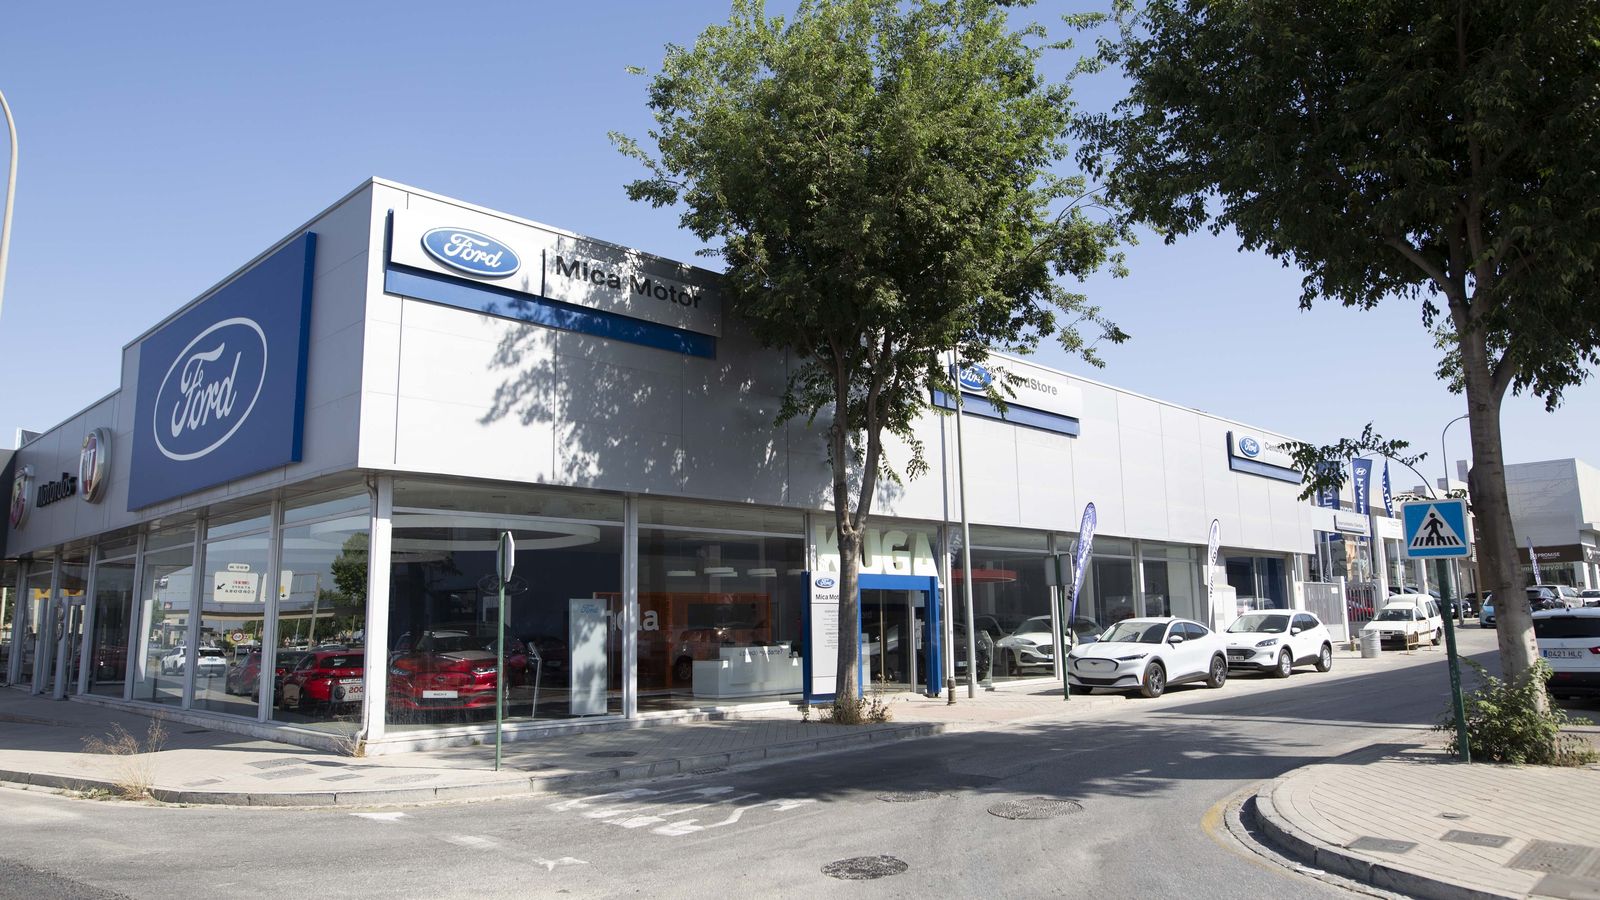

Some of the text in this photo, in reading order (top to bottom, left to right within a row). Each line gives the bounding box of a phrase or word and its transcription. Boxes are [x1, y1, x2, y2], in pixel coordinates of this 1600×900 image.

[444, 234, 503, 269] Ford
[556, 256, 701, 308] Mica Motor
[171, 342, 242, 437] Ford
[1009, 374, 1058, 396] rdStore
